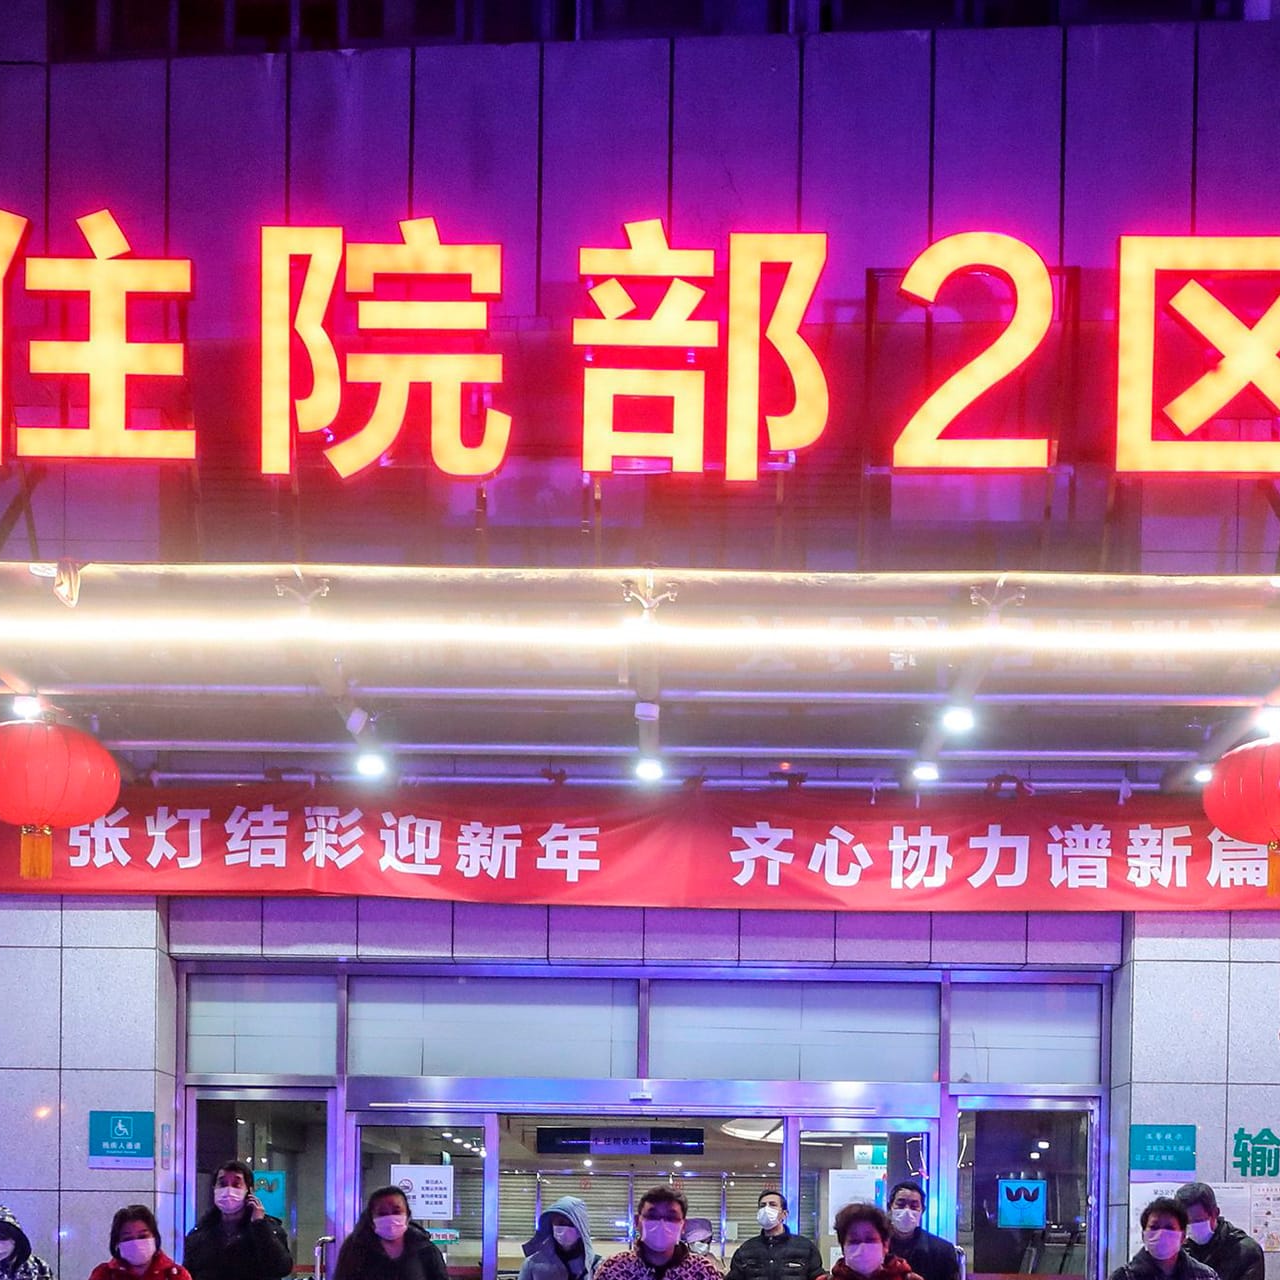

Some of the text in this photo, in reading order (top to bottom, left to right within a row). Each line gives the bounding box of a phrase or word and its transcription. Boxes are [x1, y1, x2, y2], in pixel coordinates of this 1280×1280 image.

[68, 804, 1269, 889] 张灯结彩迎新年 齐心协力谱新篇
